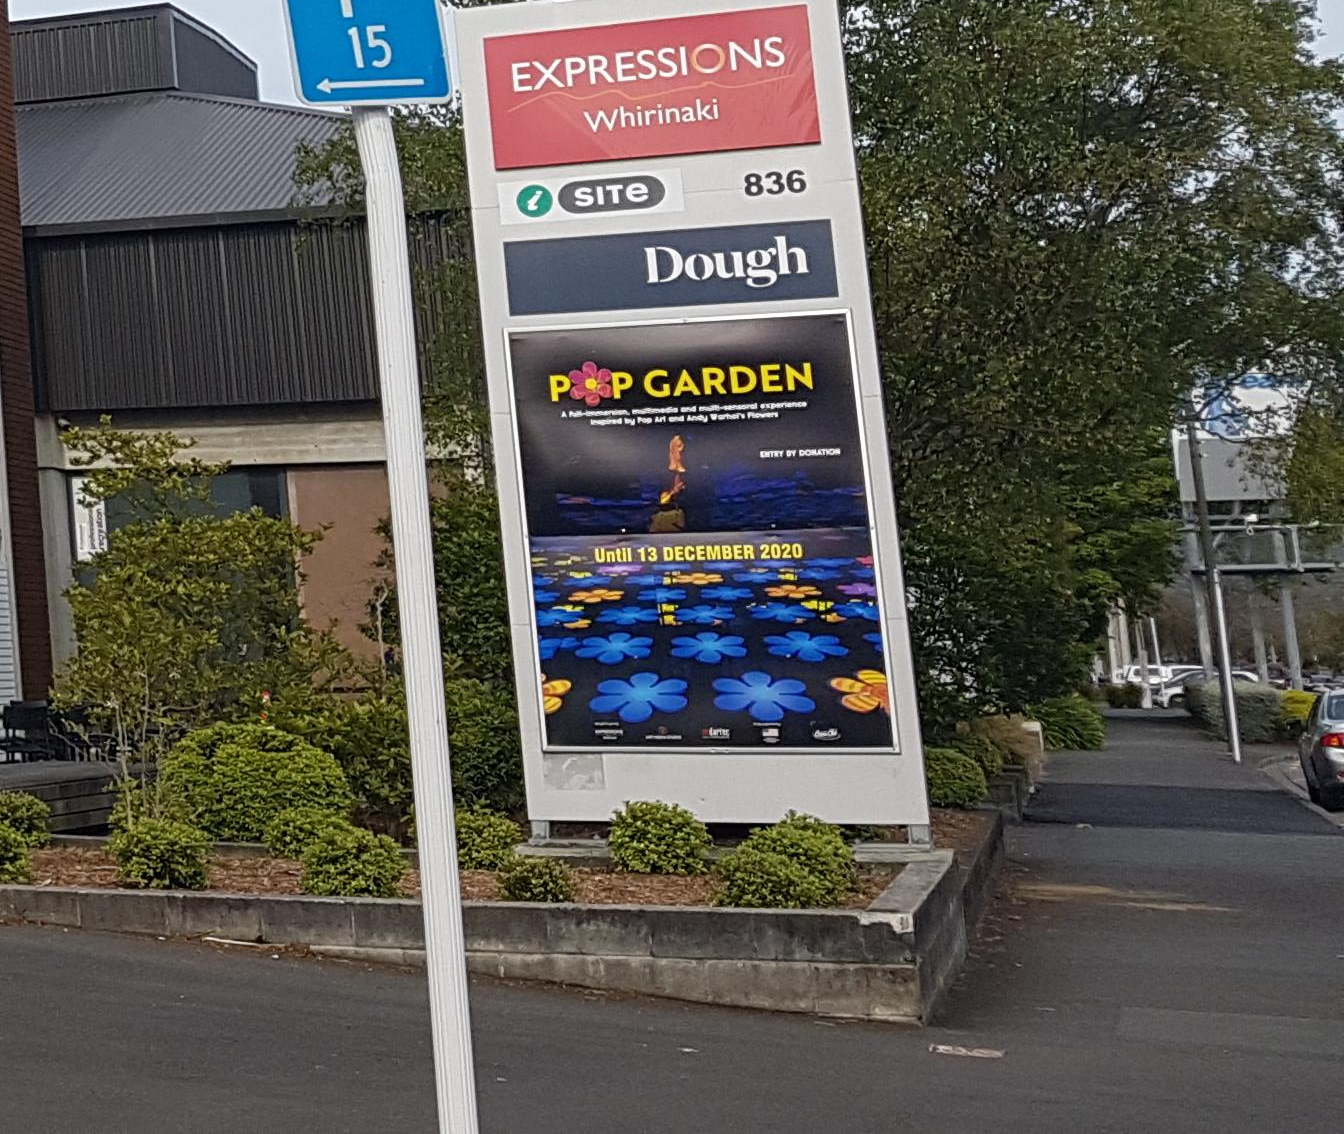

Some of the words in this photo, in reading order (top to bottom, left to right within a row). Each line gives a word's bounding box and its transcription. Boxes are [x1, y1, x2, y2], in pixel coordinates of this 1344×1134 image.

[347, 25, 393, 69] 15
[511, 36, 786, 93] EXPRESSIONS
[583, 99, 719, 133] Whirinaki
[743, 169, 808, 197] 836
[644, 235, 810, 288] Dough
[643, 362, 814, 398] GARDEN
[624, 417, 636, 426] by
[637, 416, 653, 425] Pop
[654, 415, 666, 423] Art
[668, 414, 685, 422] and
[686, 413, 708, 423] Andy
[709, 412, 746, 421] Warhol's
[680, 405, 697, 413] and
[760, 401, 808, 410] experience
[759, 449, 784, 459] ENTRY
[785, 449, 797, 458] BY
[798, 447, 841, 458] DONATION
[594, 546, 632, 563] Until
[637, 546, 658, 562] 13
[663, 544, 755, 562] DECEMBER
[760, 543, 804, 560] 2020
